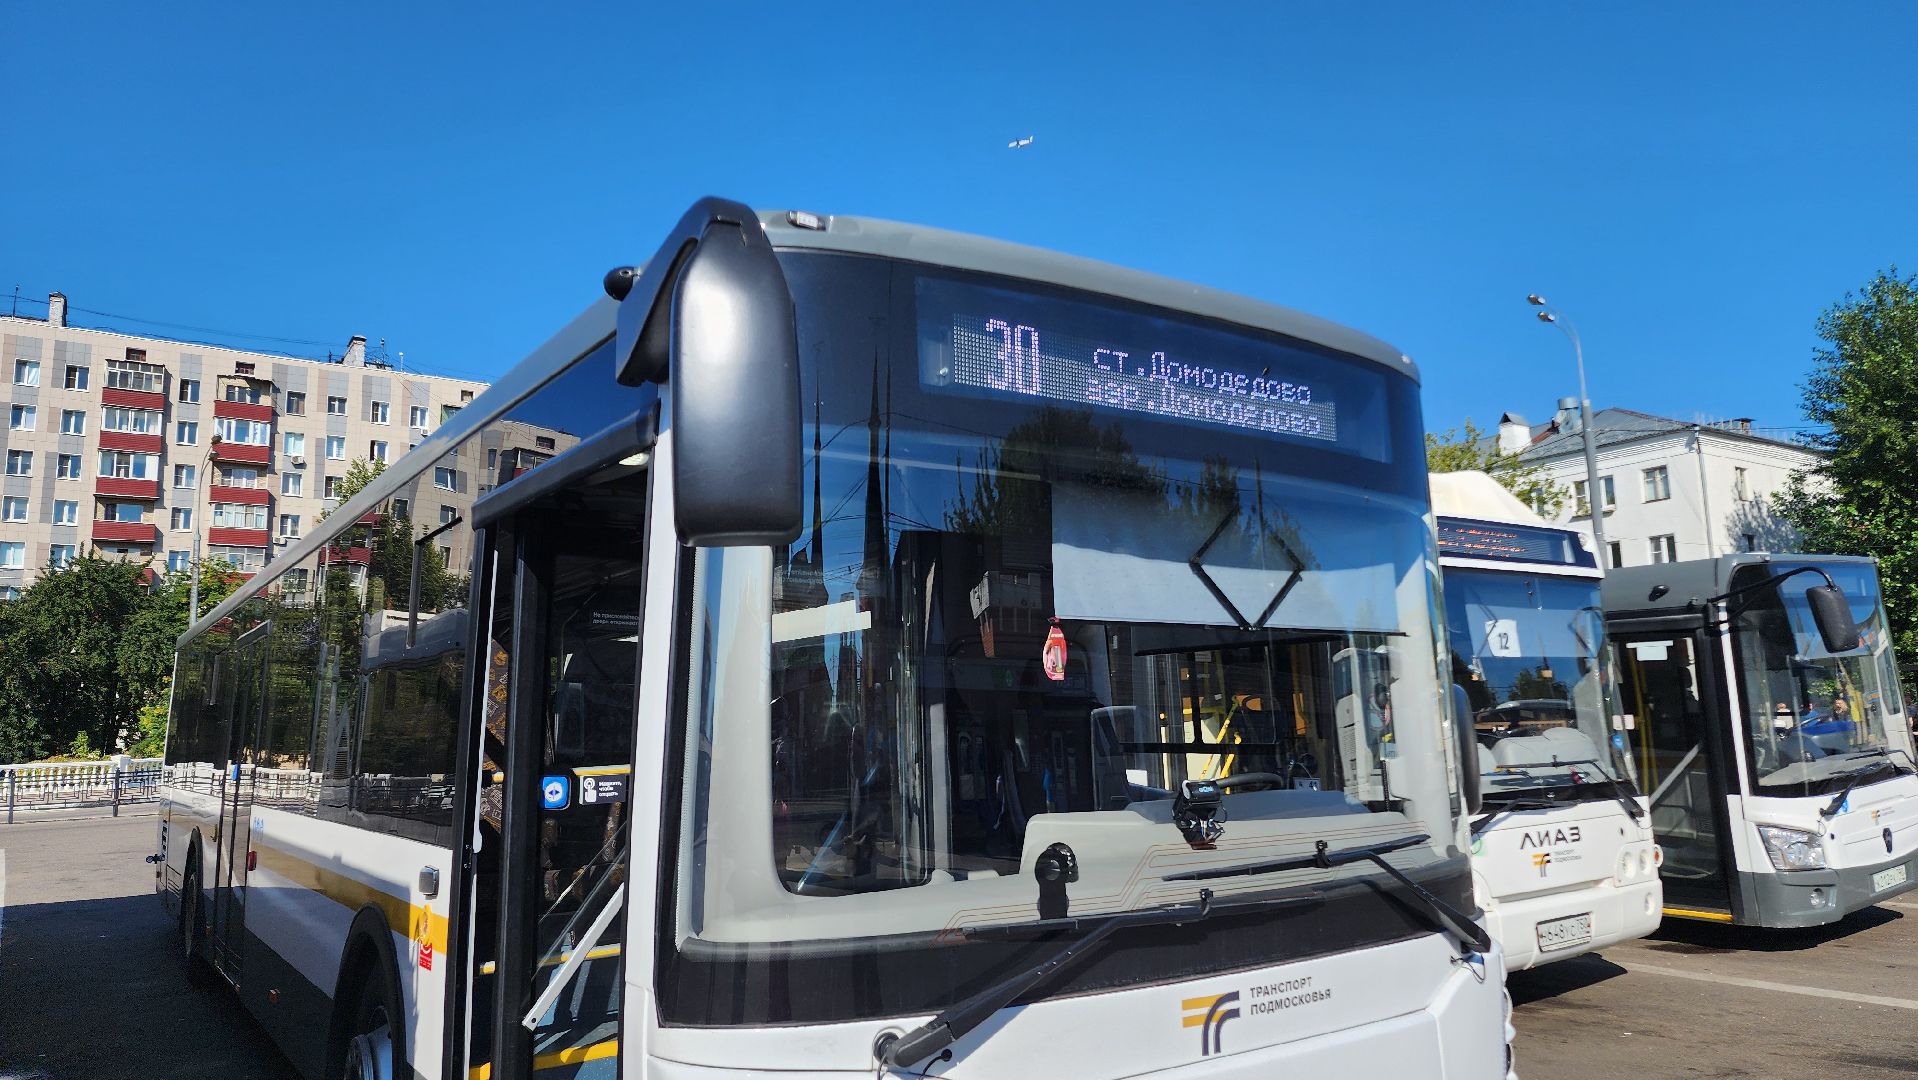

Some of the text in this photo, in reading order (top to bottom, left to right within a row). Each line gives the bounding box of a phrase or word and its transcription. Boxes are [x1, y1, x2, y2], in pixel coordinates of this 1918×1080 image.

[985, 318, 1039, 395] 30
[1498, 632, 1510, 650] 12
[1520, 826, 1582, 850] ЛИАЗ
[1250, 976, 1313, 999] ТРАНСПОРТ
[1250, 988, 1332, 1016] ПОДМОСКОВЬЯ
